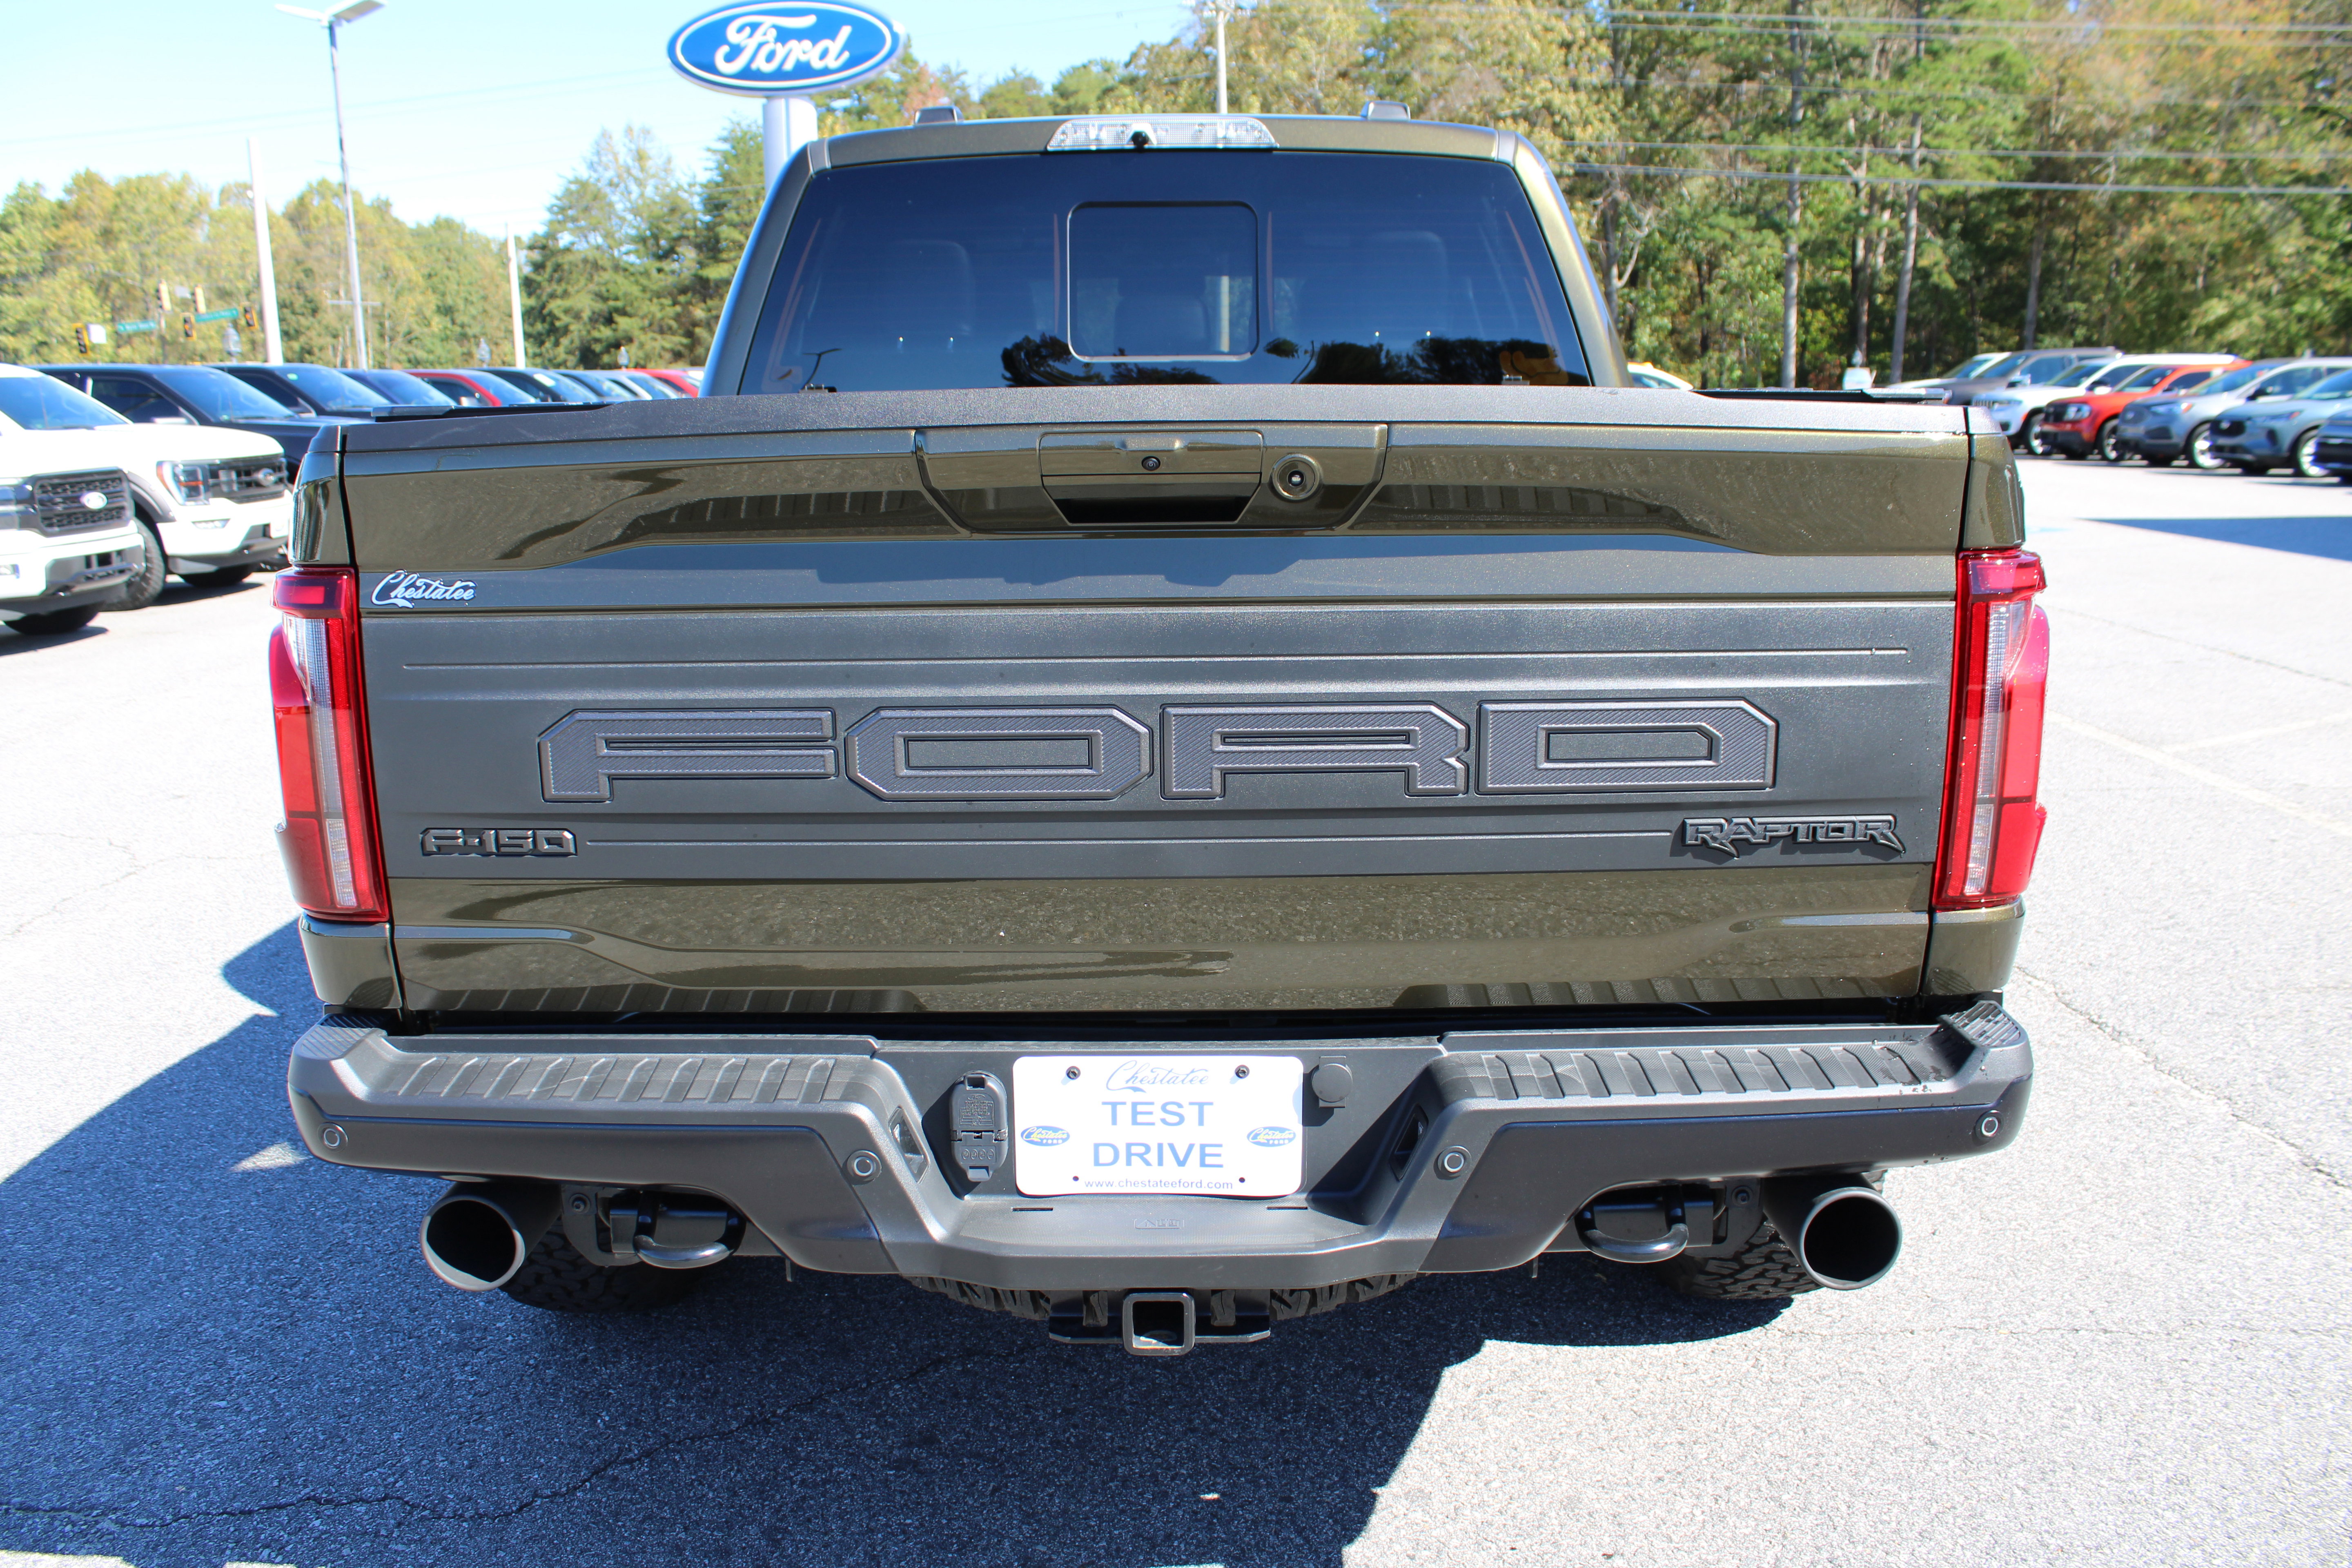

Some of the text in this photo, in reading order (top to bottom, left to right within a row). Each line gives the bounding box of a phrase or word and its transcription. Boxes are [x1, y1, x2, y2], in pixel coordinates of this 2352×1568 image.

[715, 15, 852, 75] Ford
[371, 570, 477, 608] Chestatee
[539, 700, 1778, 802] FORD
[420, 828, 577, 857] F-150
[1682, 814, 1906, 858] RAPTOR
[1106, 1060, 1209, 1093] Chestatee
[1102, 1101, 1214, 1126] TEST
[1093, 1143, 1223, 1168] DRIVE
[1084, 1178, 1233, 1189] www.chestateeford.com
